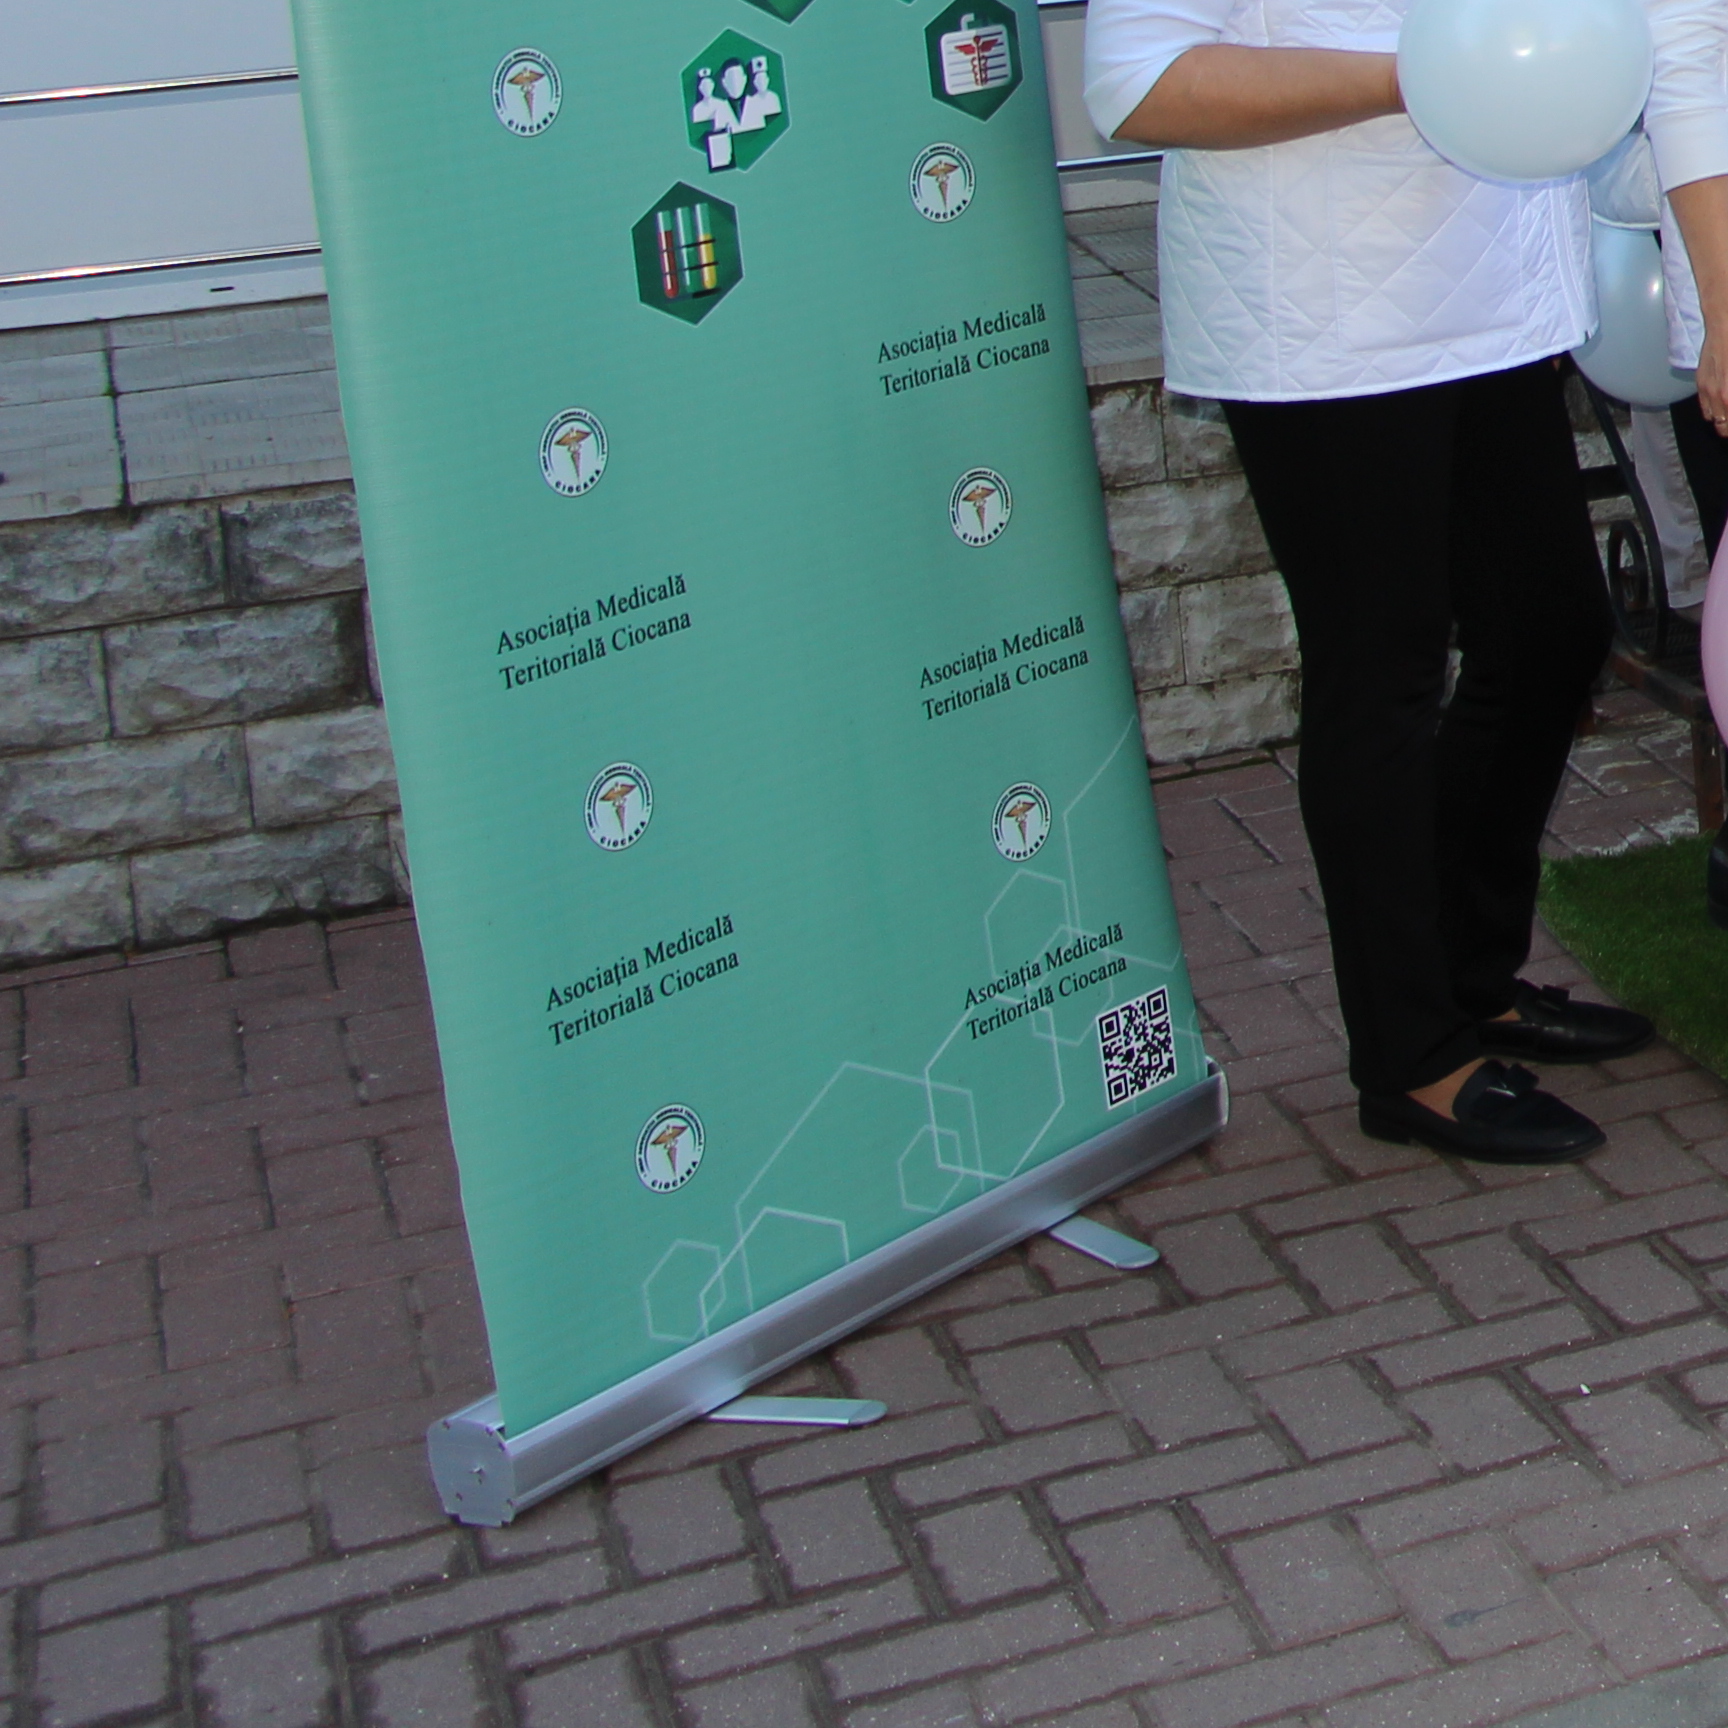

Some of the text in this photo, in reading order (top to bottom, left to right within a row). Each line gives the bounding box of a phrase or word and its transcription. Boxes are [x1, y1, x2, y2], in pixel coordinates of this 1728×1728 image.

[877, 302, 1047, 365] Asociația Medicală
[880, 336, 1051, 397] Teritorială Ciocana
[496, 573, 687, 656] Asociația Medicală
[499, 609, 692, 692] Teritorială Ciocana
[918, 614, 1085, 690] Asociația Medicală
[922, 646, 1090, 722] Teritorială Ciocana
[545, 914, 734, 1013] Asociația Medicală
[1045, 923, 1124, 976] Medicală
[548, 949, 739, 1048] Teritorială Ciocana
[966, 954, 1127, 1042] Teritorială Ciocana
